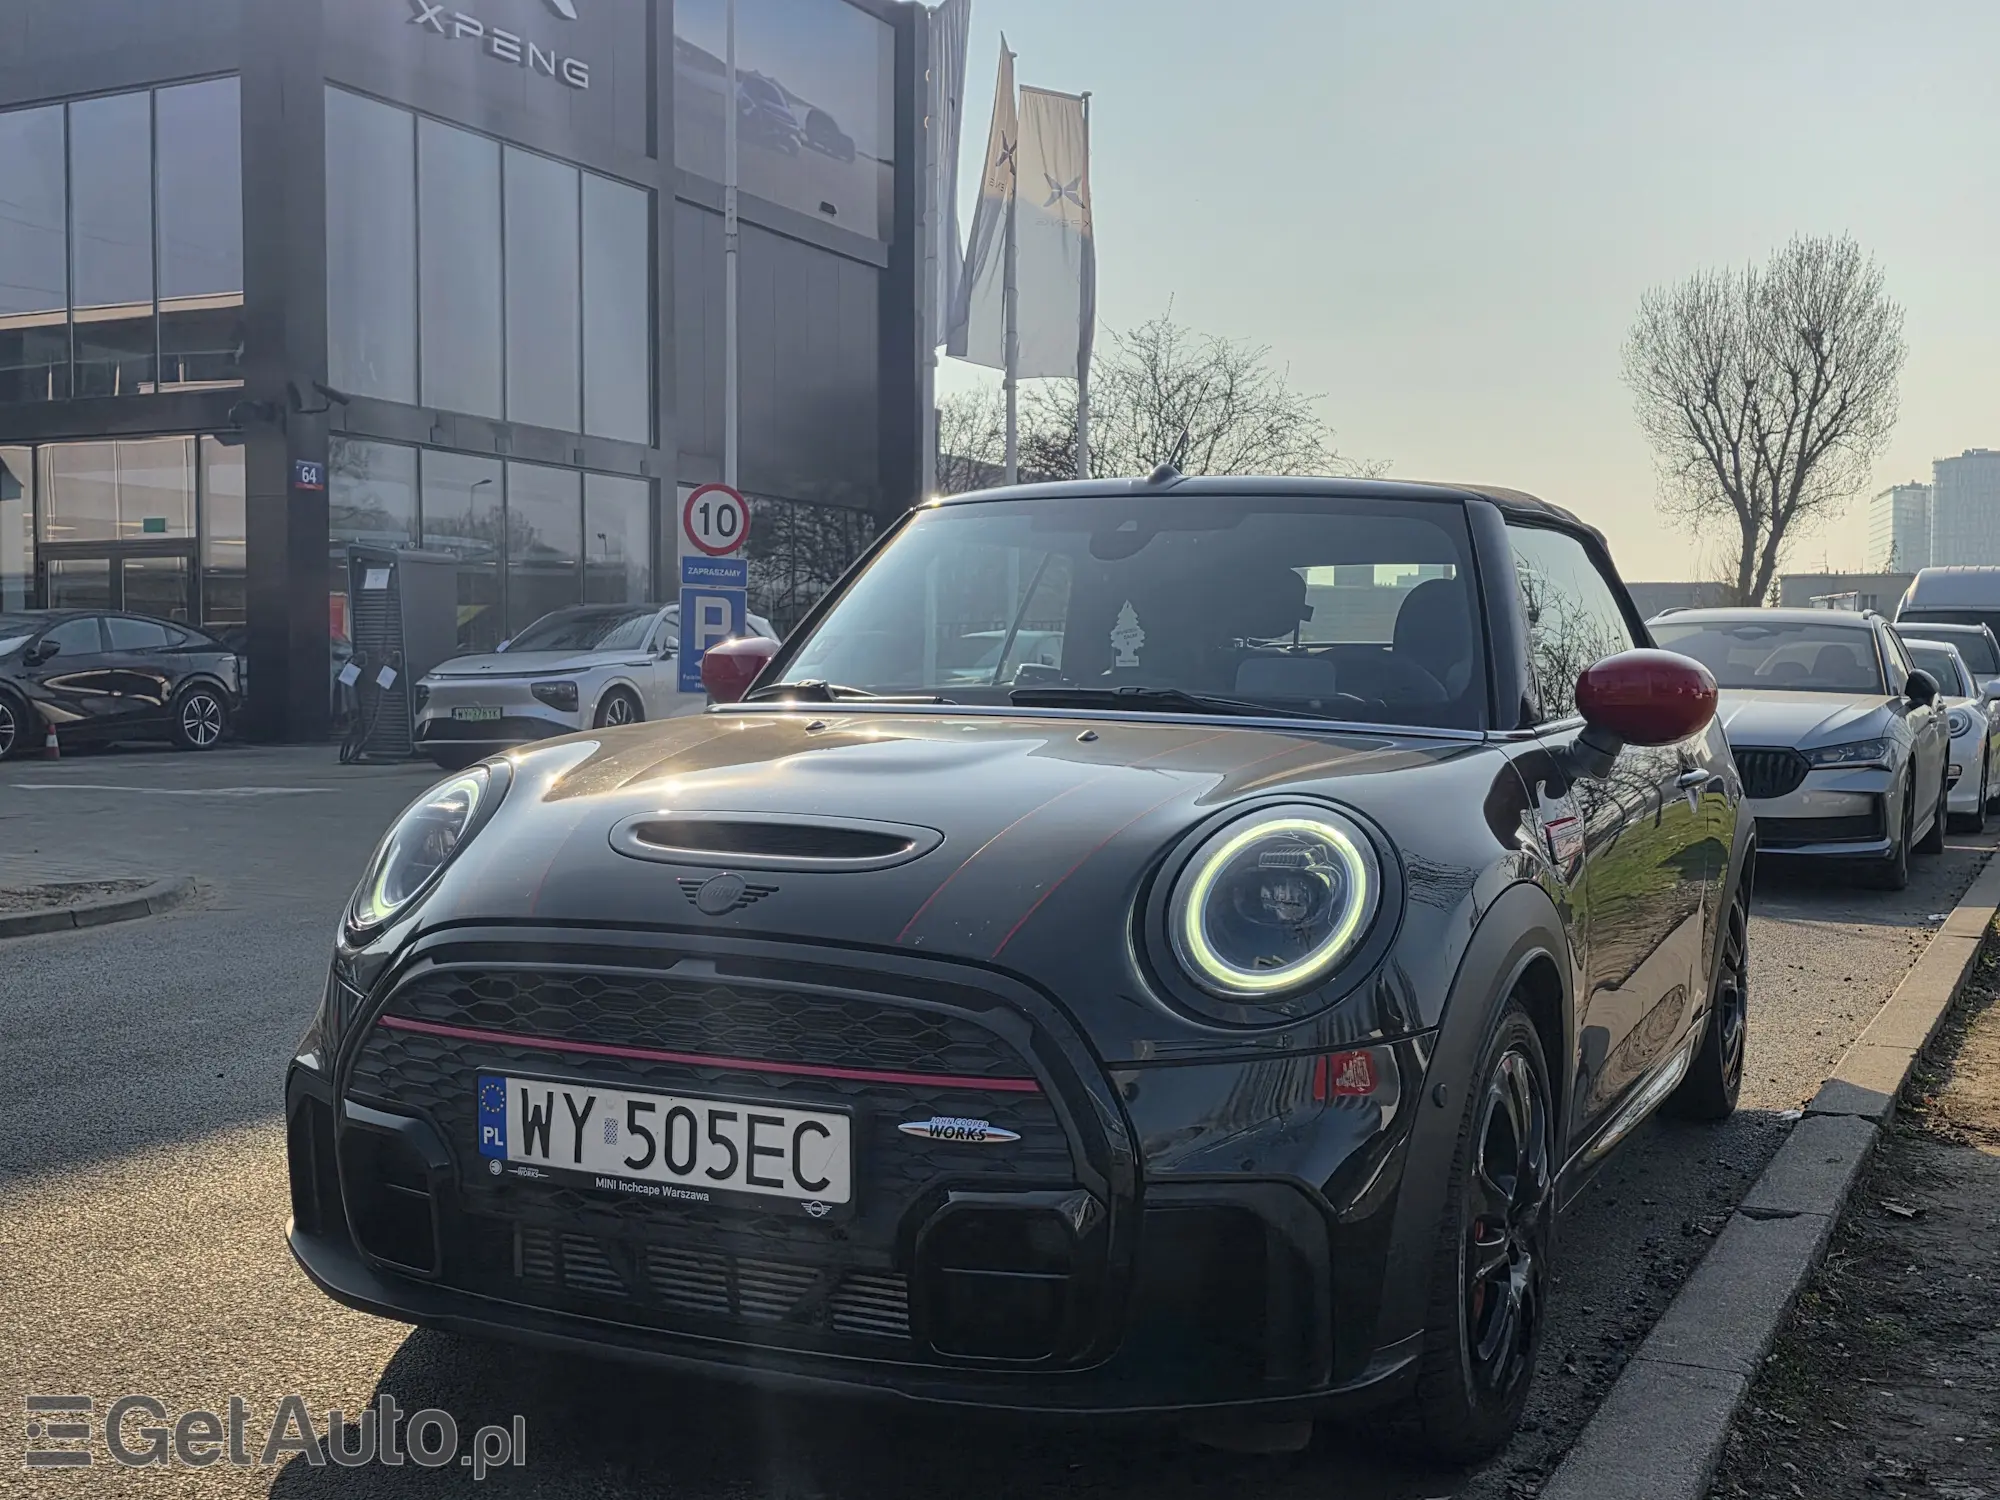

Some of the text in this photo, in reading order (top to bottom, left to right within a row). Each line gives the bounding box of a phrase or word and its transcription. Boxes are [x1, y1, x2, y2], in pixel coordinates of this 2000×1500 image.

[414, 0, 589, 89] XPENG
[302, 466, 316, 483] 64
[699, 502, 737, 537] 10
[687, 566, 742, 577] ZAPRASZAMY
[695, 596, 732, 650] P
[929, 1124, 987, 1141] WORKS
[930, 1116, 989, 1128] JOHN COOPER
[483, 1126, 504, 1146] PL
[520, 1087, 831, 1192] WY 505EC
[595, 1177, 710, 1202] MINI Inchcape Warszawa
